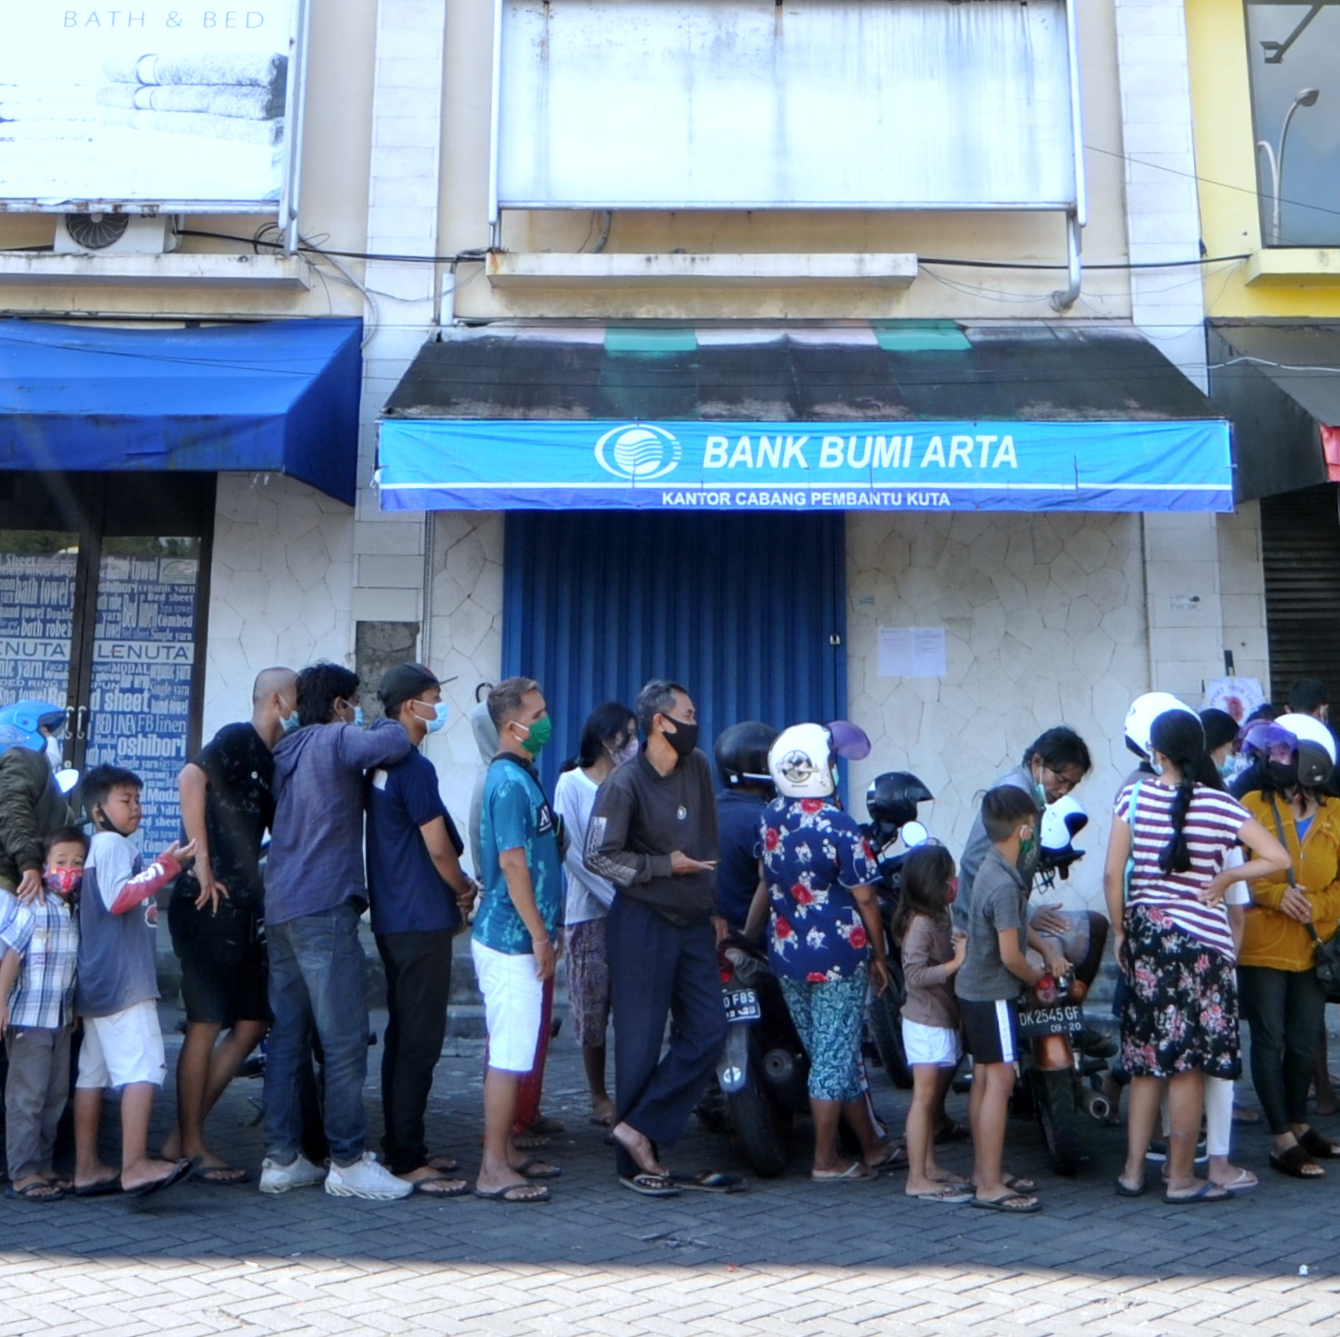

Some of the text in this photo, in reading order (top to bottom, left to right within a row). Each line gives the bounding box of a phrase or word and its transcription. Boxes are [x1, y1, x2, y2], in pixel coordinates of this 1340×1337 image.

[63, 9, 266, 30] BATH & BED
[702, 435, 1019, 470] BANK BUMI ARTA
[662, 492, 951, 507] KANTOR CABANG PEMBANTU KUTA
[97, 643, 189, 661] LENUTA
[117, 732, 187, 758] oshibori
[1017, 1009, 1035, 1027] DK
[1034, 1007, 1064, 1024] 2545
